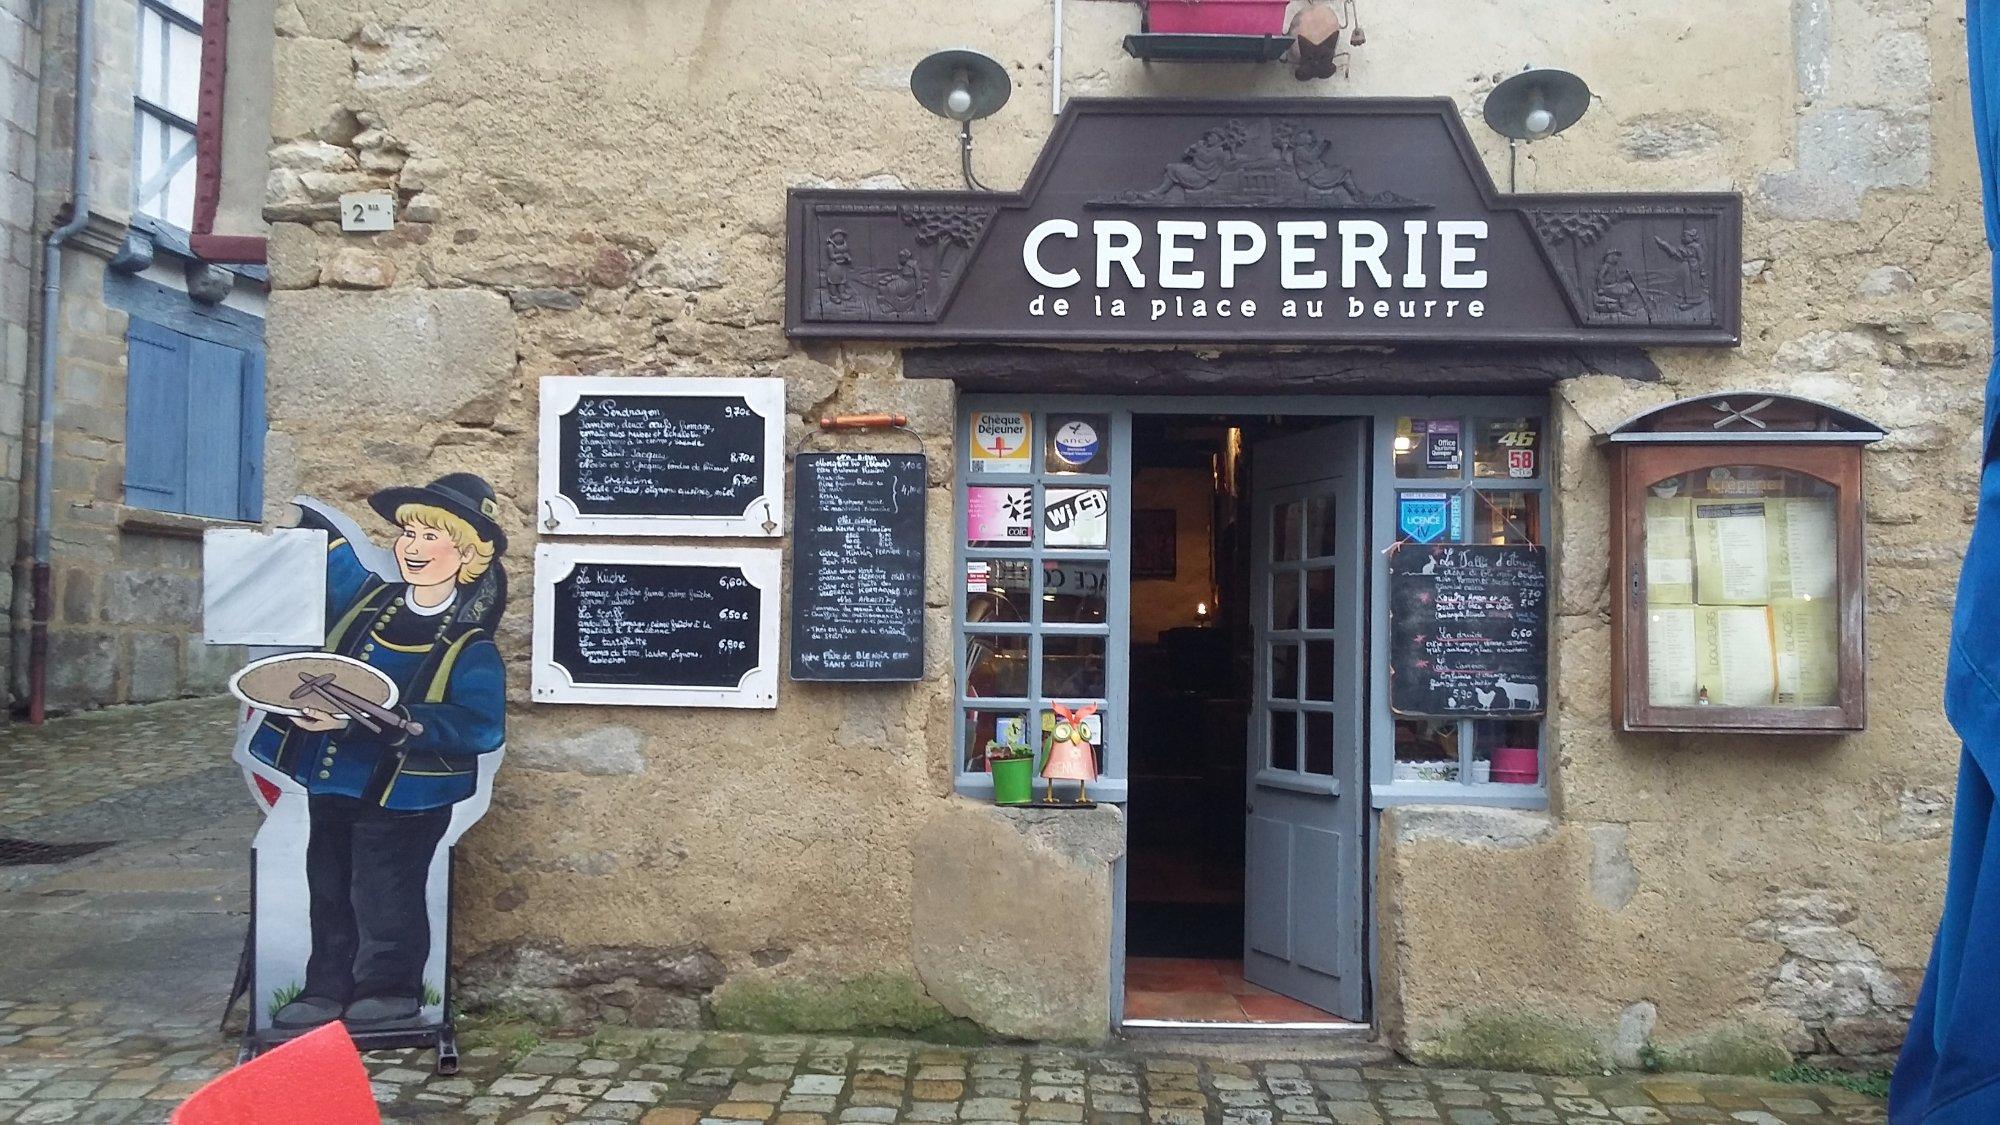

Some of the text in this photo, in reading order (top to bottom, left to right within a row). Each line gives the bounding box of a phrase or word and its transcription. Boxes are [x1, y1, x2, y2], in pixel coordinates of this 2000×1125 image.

[353, 204, 365, 223] 2
[1022, 219, 1489, 289] CREPERIE
[1029, 294, 1485, 321] de la place au beurre
[578, 400, 597, 416] La
[981, 415, 1021, 426] Chèque
[1498, 431, 1536, 447] 46
[1510, 451, 1532, 468] 58
[576, 566, 591, 584] La
